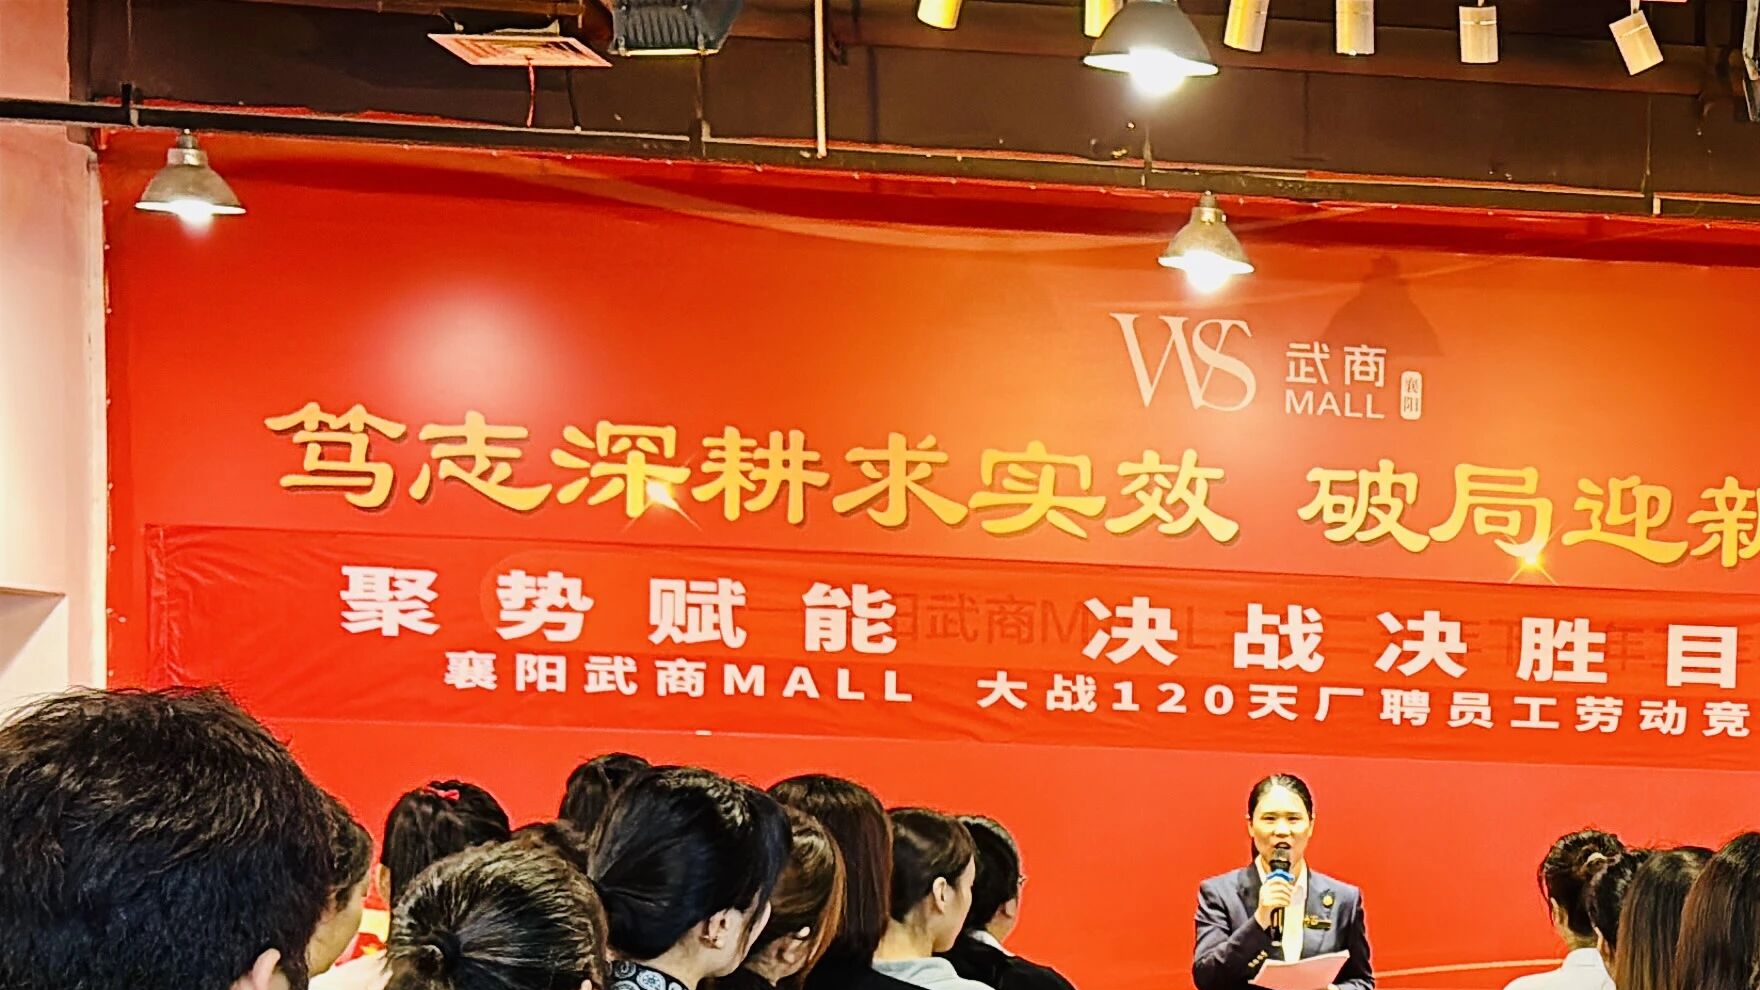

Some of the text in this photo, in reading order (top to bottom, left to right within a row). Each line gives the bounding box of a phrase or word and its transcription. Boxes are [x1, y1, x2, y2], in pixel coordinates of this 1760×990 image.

[1284, 340, 1388, 388] 武商
[1284, 388, 1386, 420] MALL
[264, 401, 1241, 545] 笃志深耕求实效
[339, 566, 898, 654] 聚势赋能
[443, 649, 913, 704] 襄阳武商MALL
